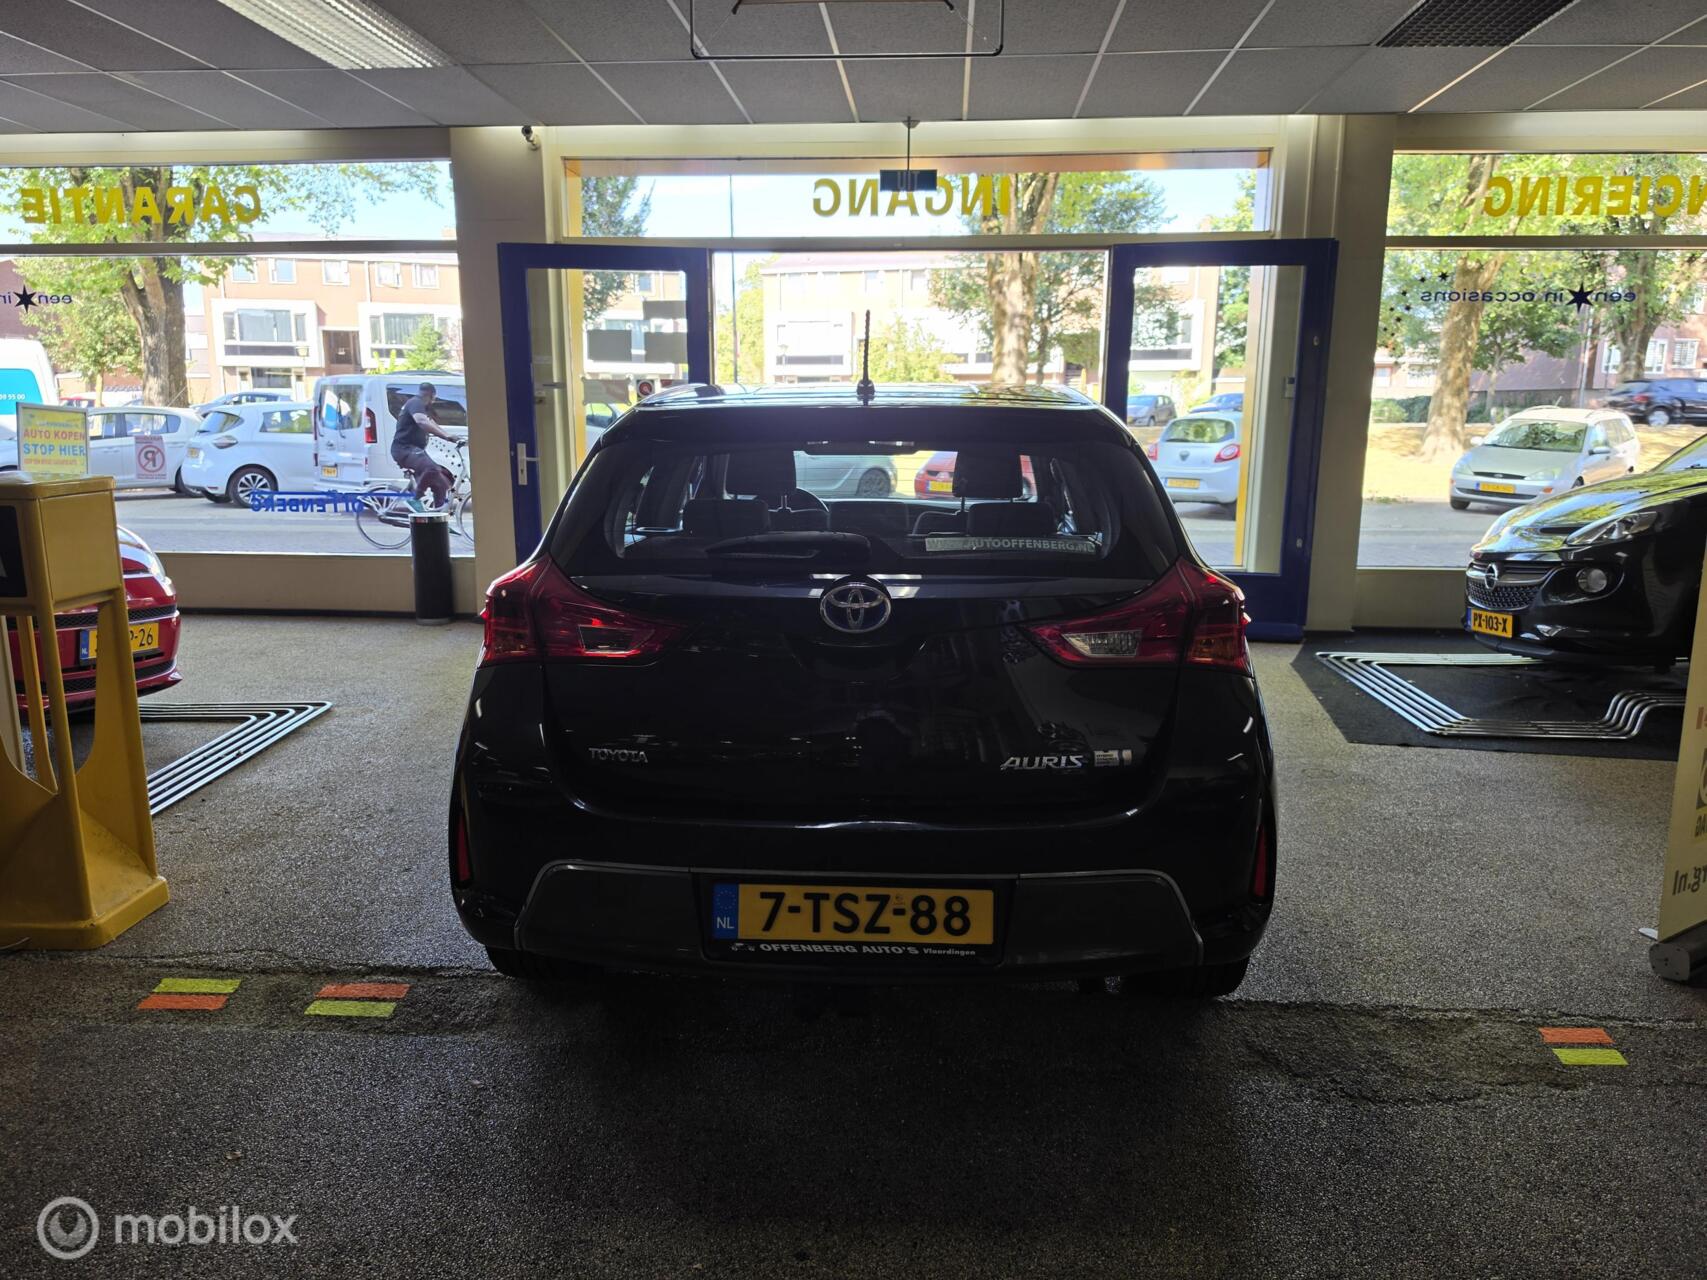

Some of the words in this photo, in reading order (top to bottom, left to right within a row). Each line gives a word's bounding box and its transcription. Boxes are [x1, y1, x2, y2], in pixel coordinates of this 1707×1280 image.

[23, 428, 51, 440] AUTO
[54, 429, 86, 441] KOPEN
[23, 443, 55, 455] STOP
[59, 445, 86, 457] HIER
[1473, 612, 1509, 634] PX-103-X
[587, 746, 649, 764] TOYOTA
[1000, 754, 1084, 771] AURIS
[716, 917, 735, 930] NL
[759, 891, 972, 937] 7-TSZ-88
[759, 943, 859, 955] OFFENBERG
[862, 944, 920, 956] AUTO'S
